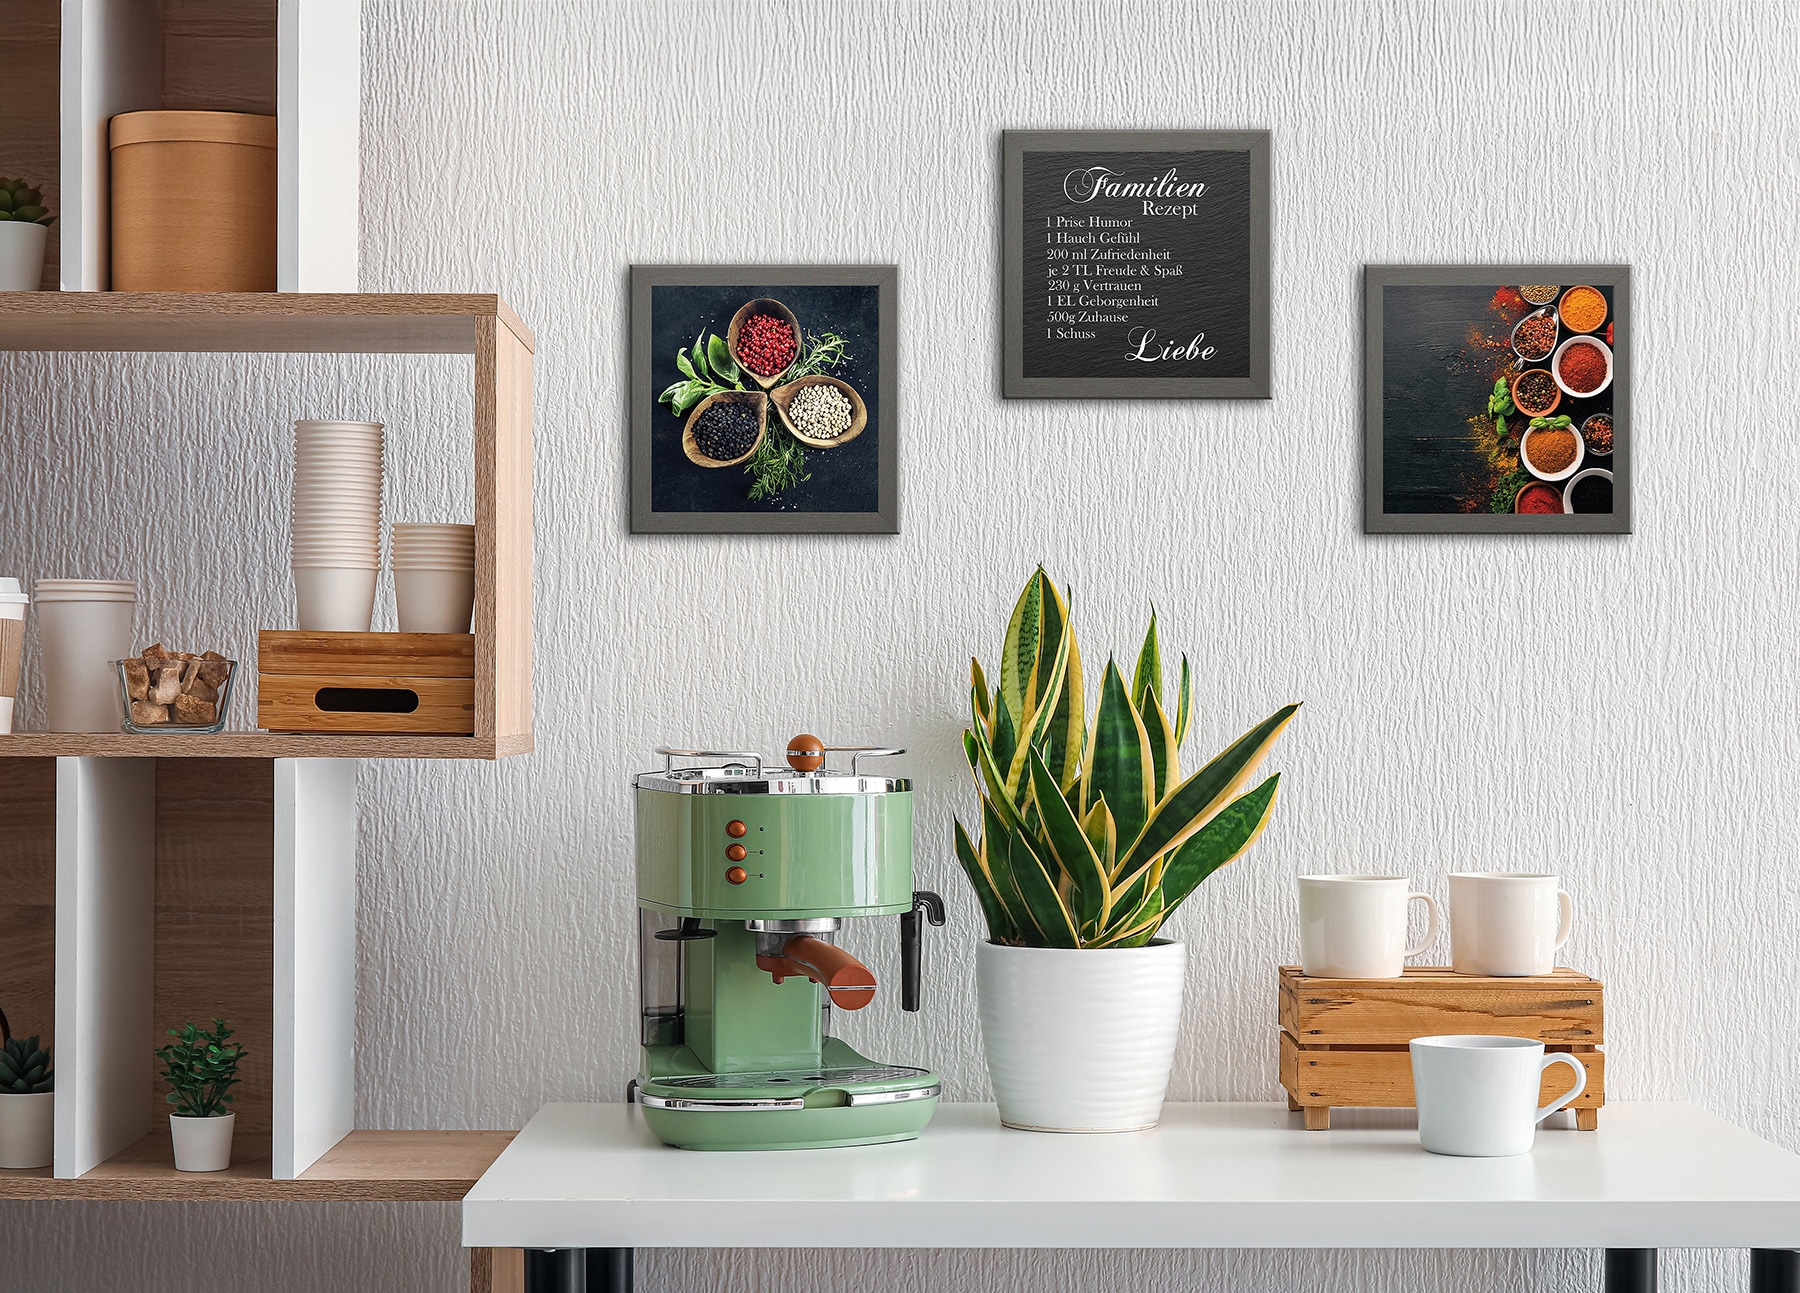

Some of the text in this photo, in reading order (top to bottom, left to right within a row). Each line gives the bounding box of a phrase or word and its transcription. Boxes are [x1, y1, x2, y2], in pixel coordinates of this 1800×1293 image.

[1063, 166, 1211, 204] Familien
[1142, 201, 1198, 219] Rezept
[1047, 216, 1133, 228] 1 Prise Humor
[1047, 232, 1140, 244] 1 Hauch Gefühl
[1047, 248, 1171, 260] 200 ml Zufriedenheit
[1047, 264, 1183, 279] je 2 TL Freude & Spaß
[1048, 280, 1142, 293] 230 g Vertrauen
[1047, 295, 1158, 309] 1 EL Geborgenheit
[1047, 311, 1129, 325] 500g Zuhause
[1047, 327, 1096, 339] 1 Schuss
[1124, 325, 1218, 362] Liebe
